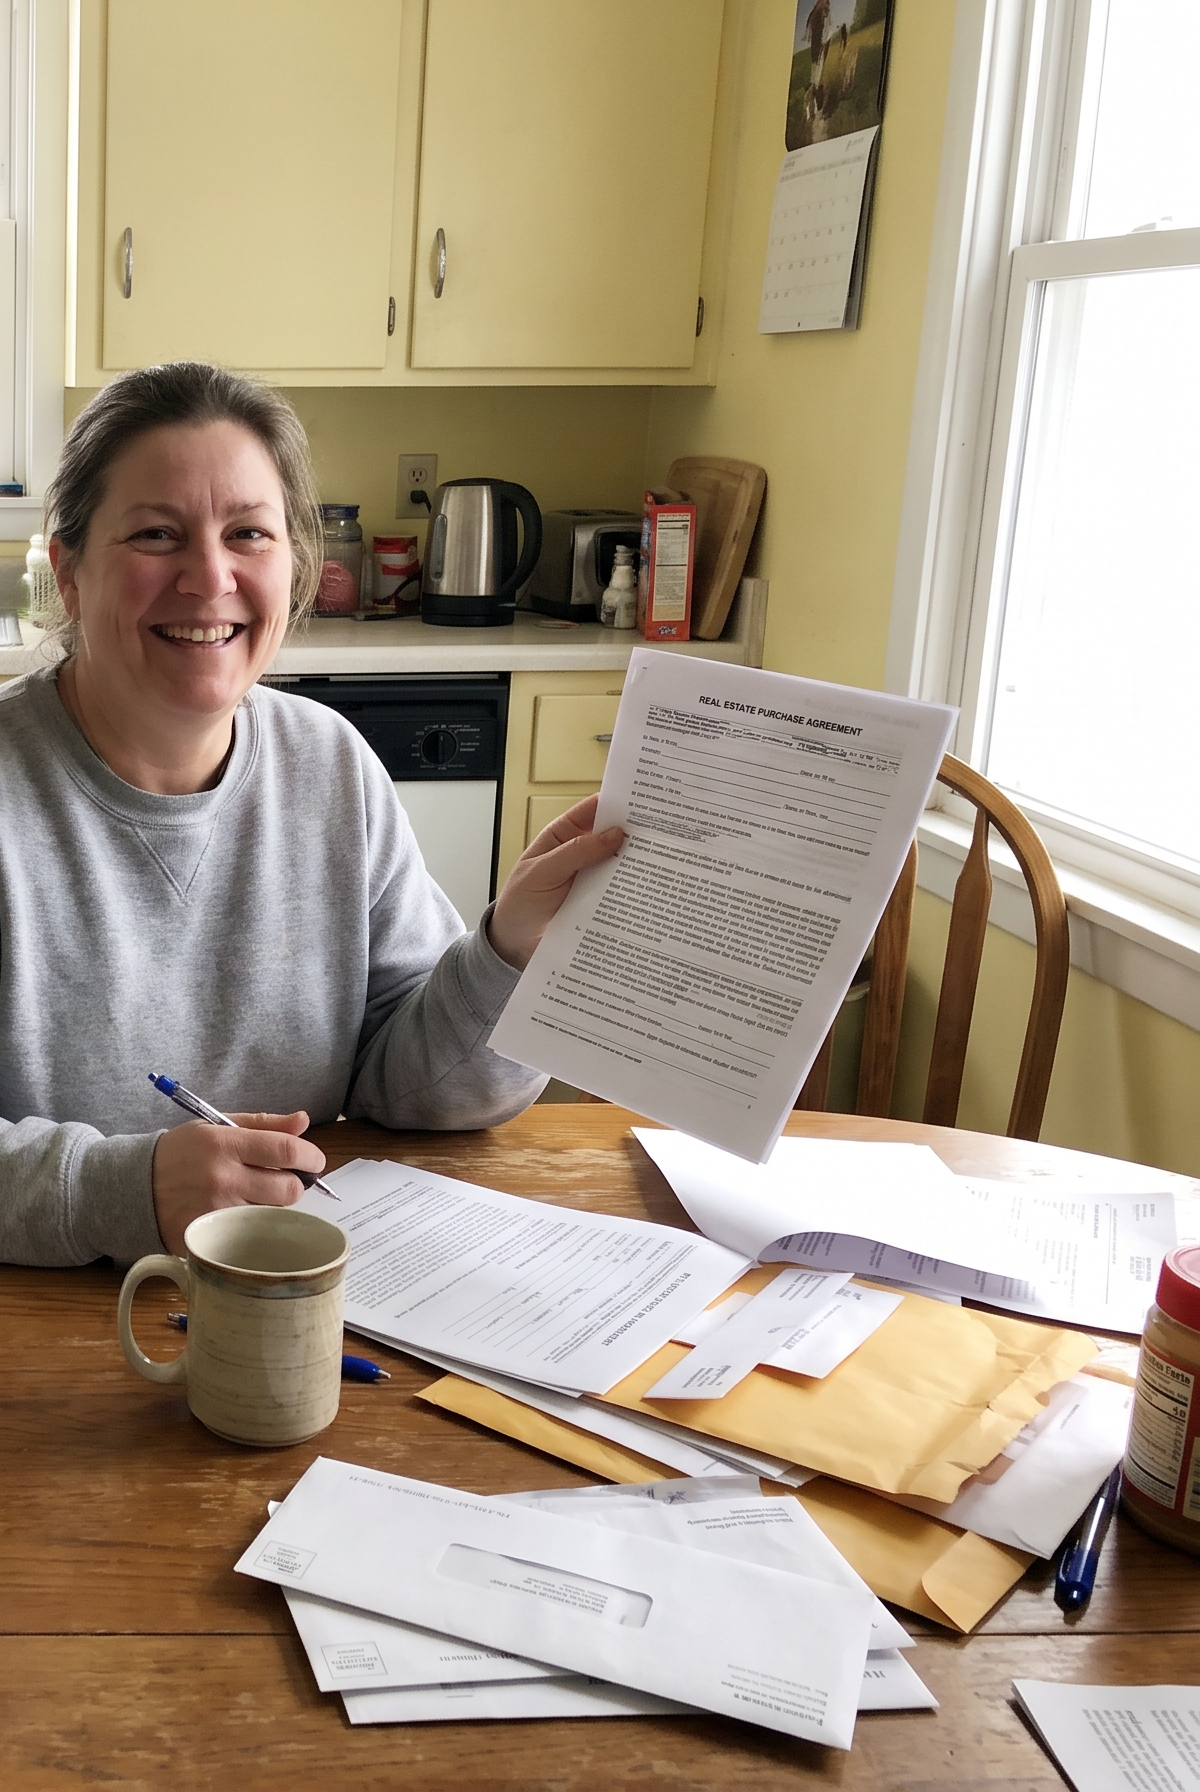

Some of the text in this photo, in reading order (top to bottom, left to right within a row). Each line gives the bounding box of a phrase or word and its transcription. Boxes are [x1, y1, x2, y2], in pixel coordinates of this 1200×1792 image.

[698, 695, 863, 737] REAL ESTATE PURCHASE AGREEMENT
